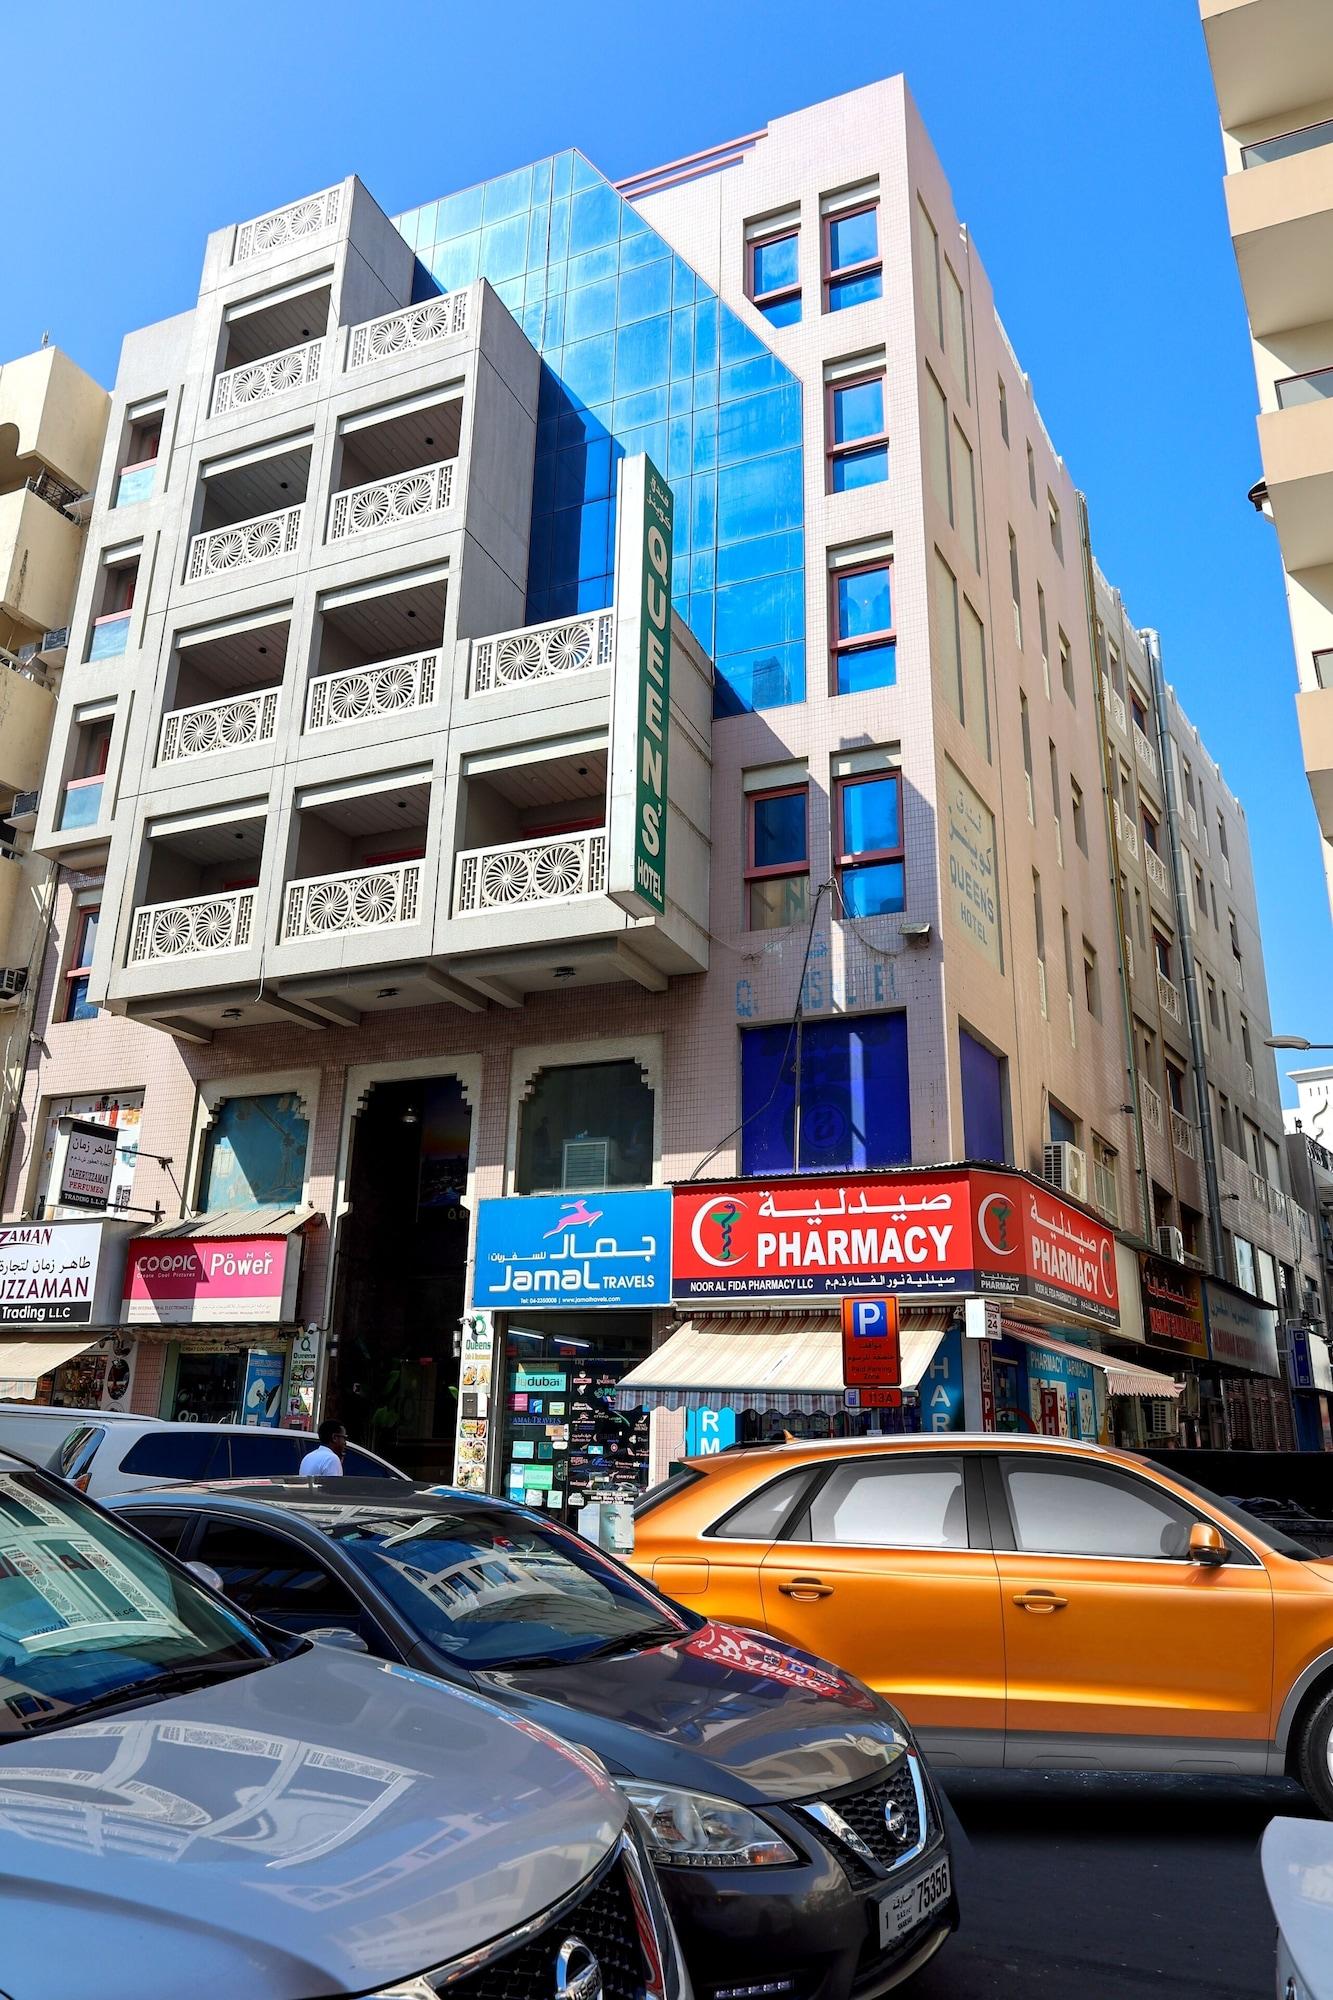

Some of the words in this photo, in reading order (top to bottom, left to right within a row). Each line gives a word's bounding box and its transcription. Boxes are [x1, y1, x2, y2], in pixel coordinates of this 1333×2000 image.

[636, 854, 663, 903] HOTEL
[960, 902, 988, 945] HOTEL
[72, 1138, 90, 1153] زمان
[92, 1145, 113, 1156] طاهر
[69, 1181, 104, 1194] PERFUMES
[64, 1192, 90, 1203] TRADING
[757, 1188, 953, 1226] صيدلية
[1029, 1193, 1097, 1254] صيدلية
[756, 1225, 954, 1269] PHARMACY
[32, 1258, 55, 1274] زمان
[58, 1255, 91, 1274] طاهر
[137, 1254, 198, 1272] COOPIC
[1031, 1234, 1099, 1295] PHARMACY
[172, 1271, 196, 1279] Pictures
[602, 1275, 655, 1289] TRAVELS
[886, 1274, 906, 1288] نور
[906, 1273, 956, 1286] صيدلية
[690, 1282, 715, 1293] NOOR
[715, 1281, 727, 1292] AL
[728, 1281, 748, 1291] FIDA
[748, 1279, 797, 1291] PHARMACY
[797, 1279, 814, 1290] LLC
[980, 1279, 1020, 1292] PHARMACY
[1034, 1282, 1045, 1294] NOOR
[2, 1305, 46, 1322] Trading
[859, 1303, 881, 1335] P
[987, 1312, 998, 1320] OPEN
[987, 1319, 998, 1330] 24
[465, 1339, 492, 1350] Queens
[1030, 1351, 1064, 1374] PHARMACY
[851, 1365, 866, 1373] Paid
[868, 1366, 893, 1375] Parking
[532, 1416, 562, 1425] TRAVELS
[917, 1862, 948, 1914] 75356
[885, 1911, 889, 1930] 1
